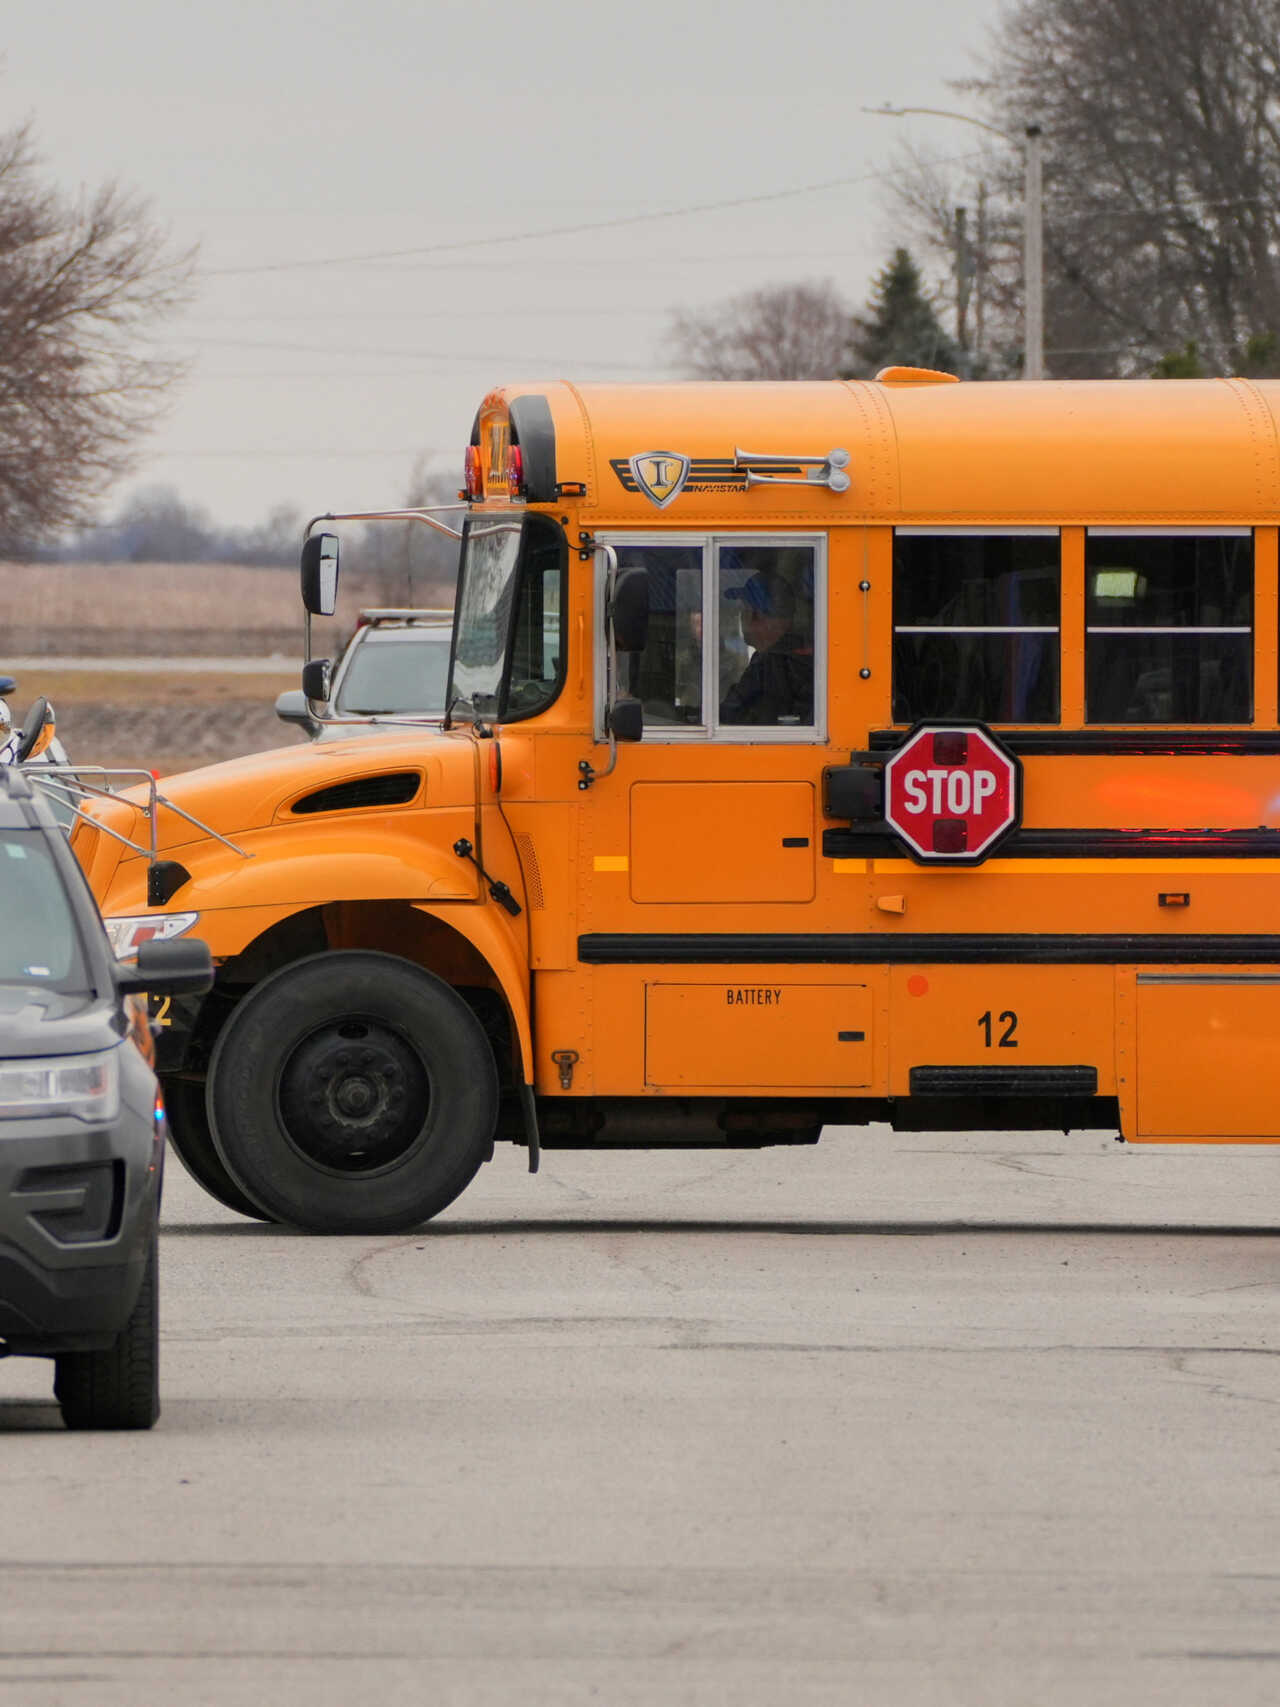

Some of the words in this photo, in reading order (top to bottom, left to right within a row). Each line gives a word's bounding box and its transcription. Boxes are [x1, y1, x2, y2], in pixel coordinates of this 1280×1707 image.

[692, 485, 746, 493] NAVISTAR
[904, 769, 997, 815] STOP
[726, 989, 782, 1005] BATTERY
[977, 1011, 1019, 1048] 12
